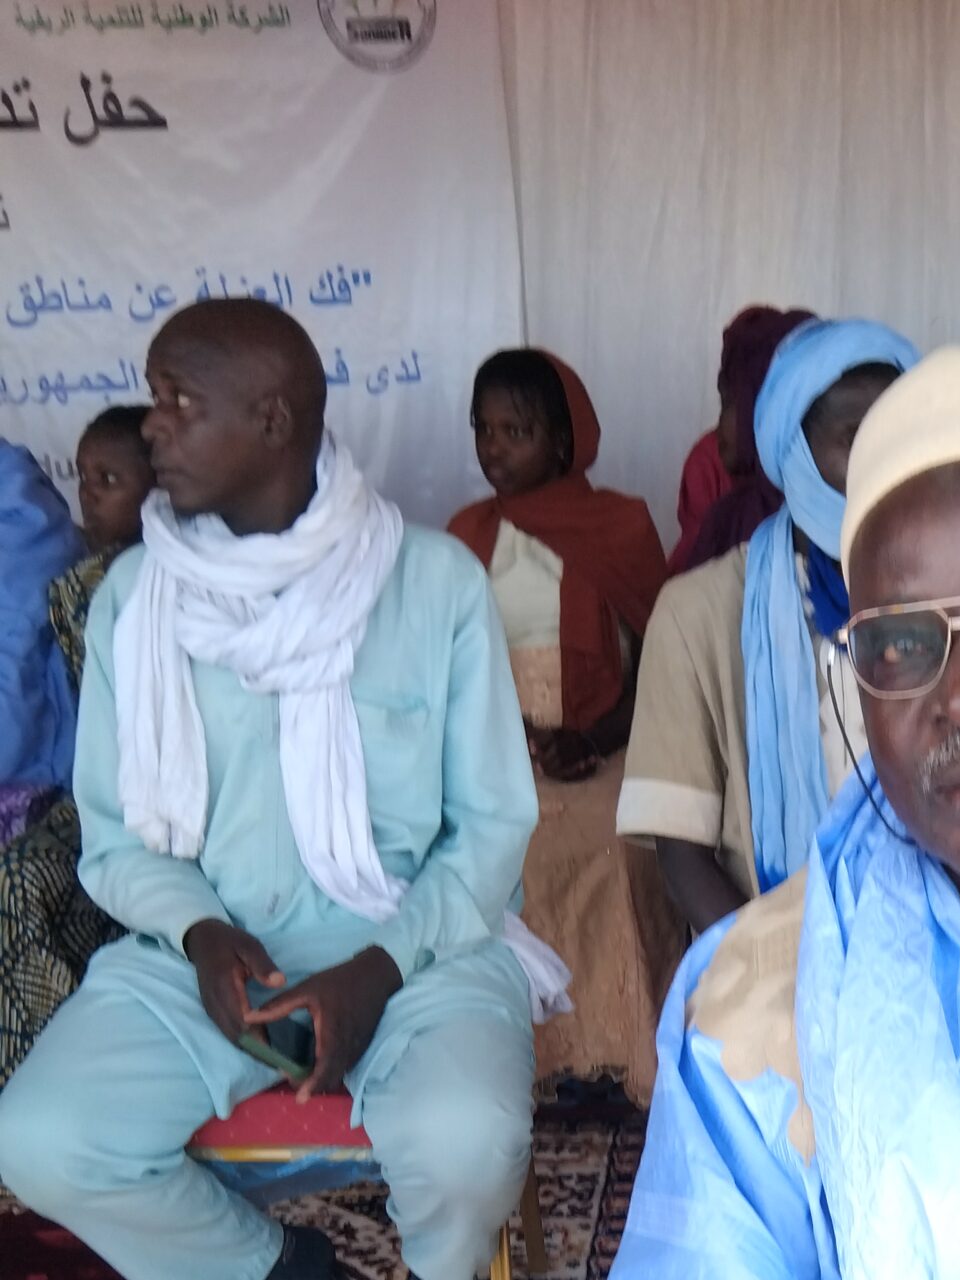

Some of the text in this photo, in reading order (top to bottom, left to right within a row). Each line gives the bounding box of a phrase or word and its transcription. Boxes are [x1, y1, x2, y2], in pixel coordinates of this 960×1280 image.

[64, 69, 168, 146] حفل
[6, 274, 112, 328] مناطق
[128, 281, 177, 323] عن
